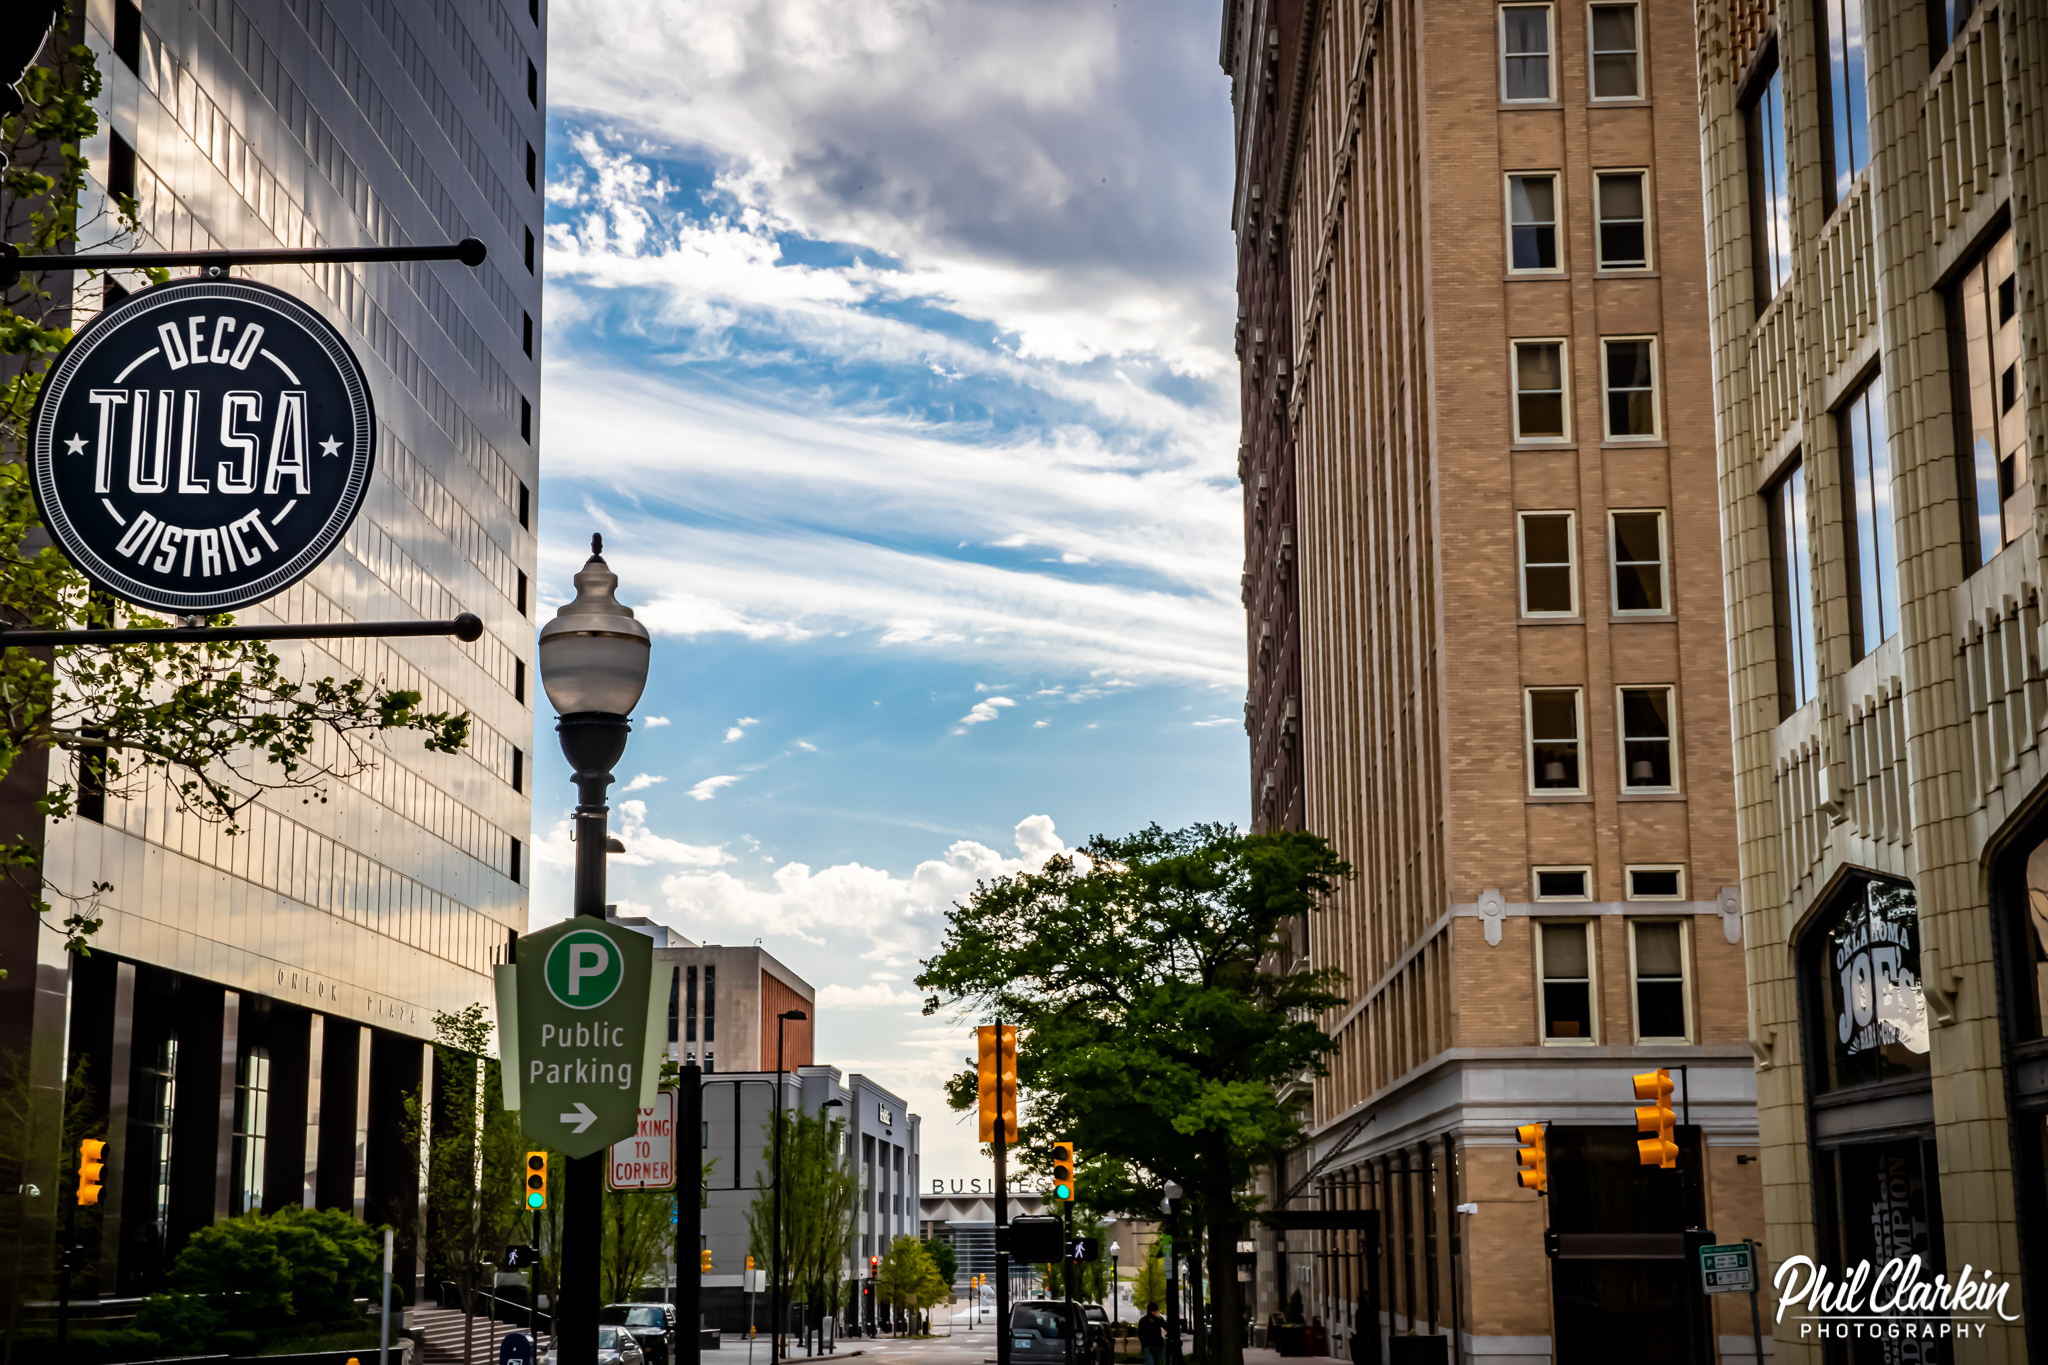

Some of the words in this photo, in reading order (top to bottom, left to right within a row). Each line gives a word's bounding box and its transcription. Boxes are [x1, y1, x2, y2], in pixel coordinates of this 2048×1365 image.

[158, 315, 264, 371] DECO
[89, 389, 311, 494] TULSA
[115, 507, 279, 577] DISTRICT
[568, 943, 609, 996] P
[1836, 921, 1910, 970] OKLAHOMA
[277, 968, 337, 1001] ONEOK
[367, 996, 415, 1024] PLAZA
[1838, 946, 1918, 1044] JOE'S
[541, 1021, 624, 1048] Public
[530, 1058, 632, 1090] Parking
[635, 1141, 650, 1159] TO
[636, 1119, 669, 1138] KING
[616, 1162, 669, 1181] CORNER
